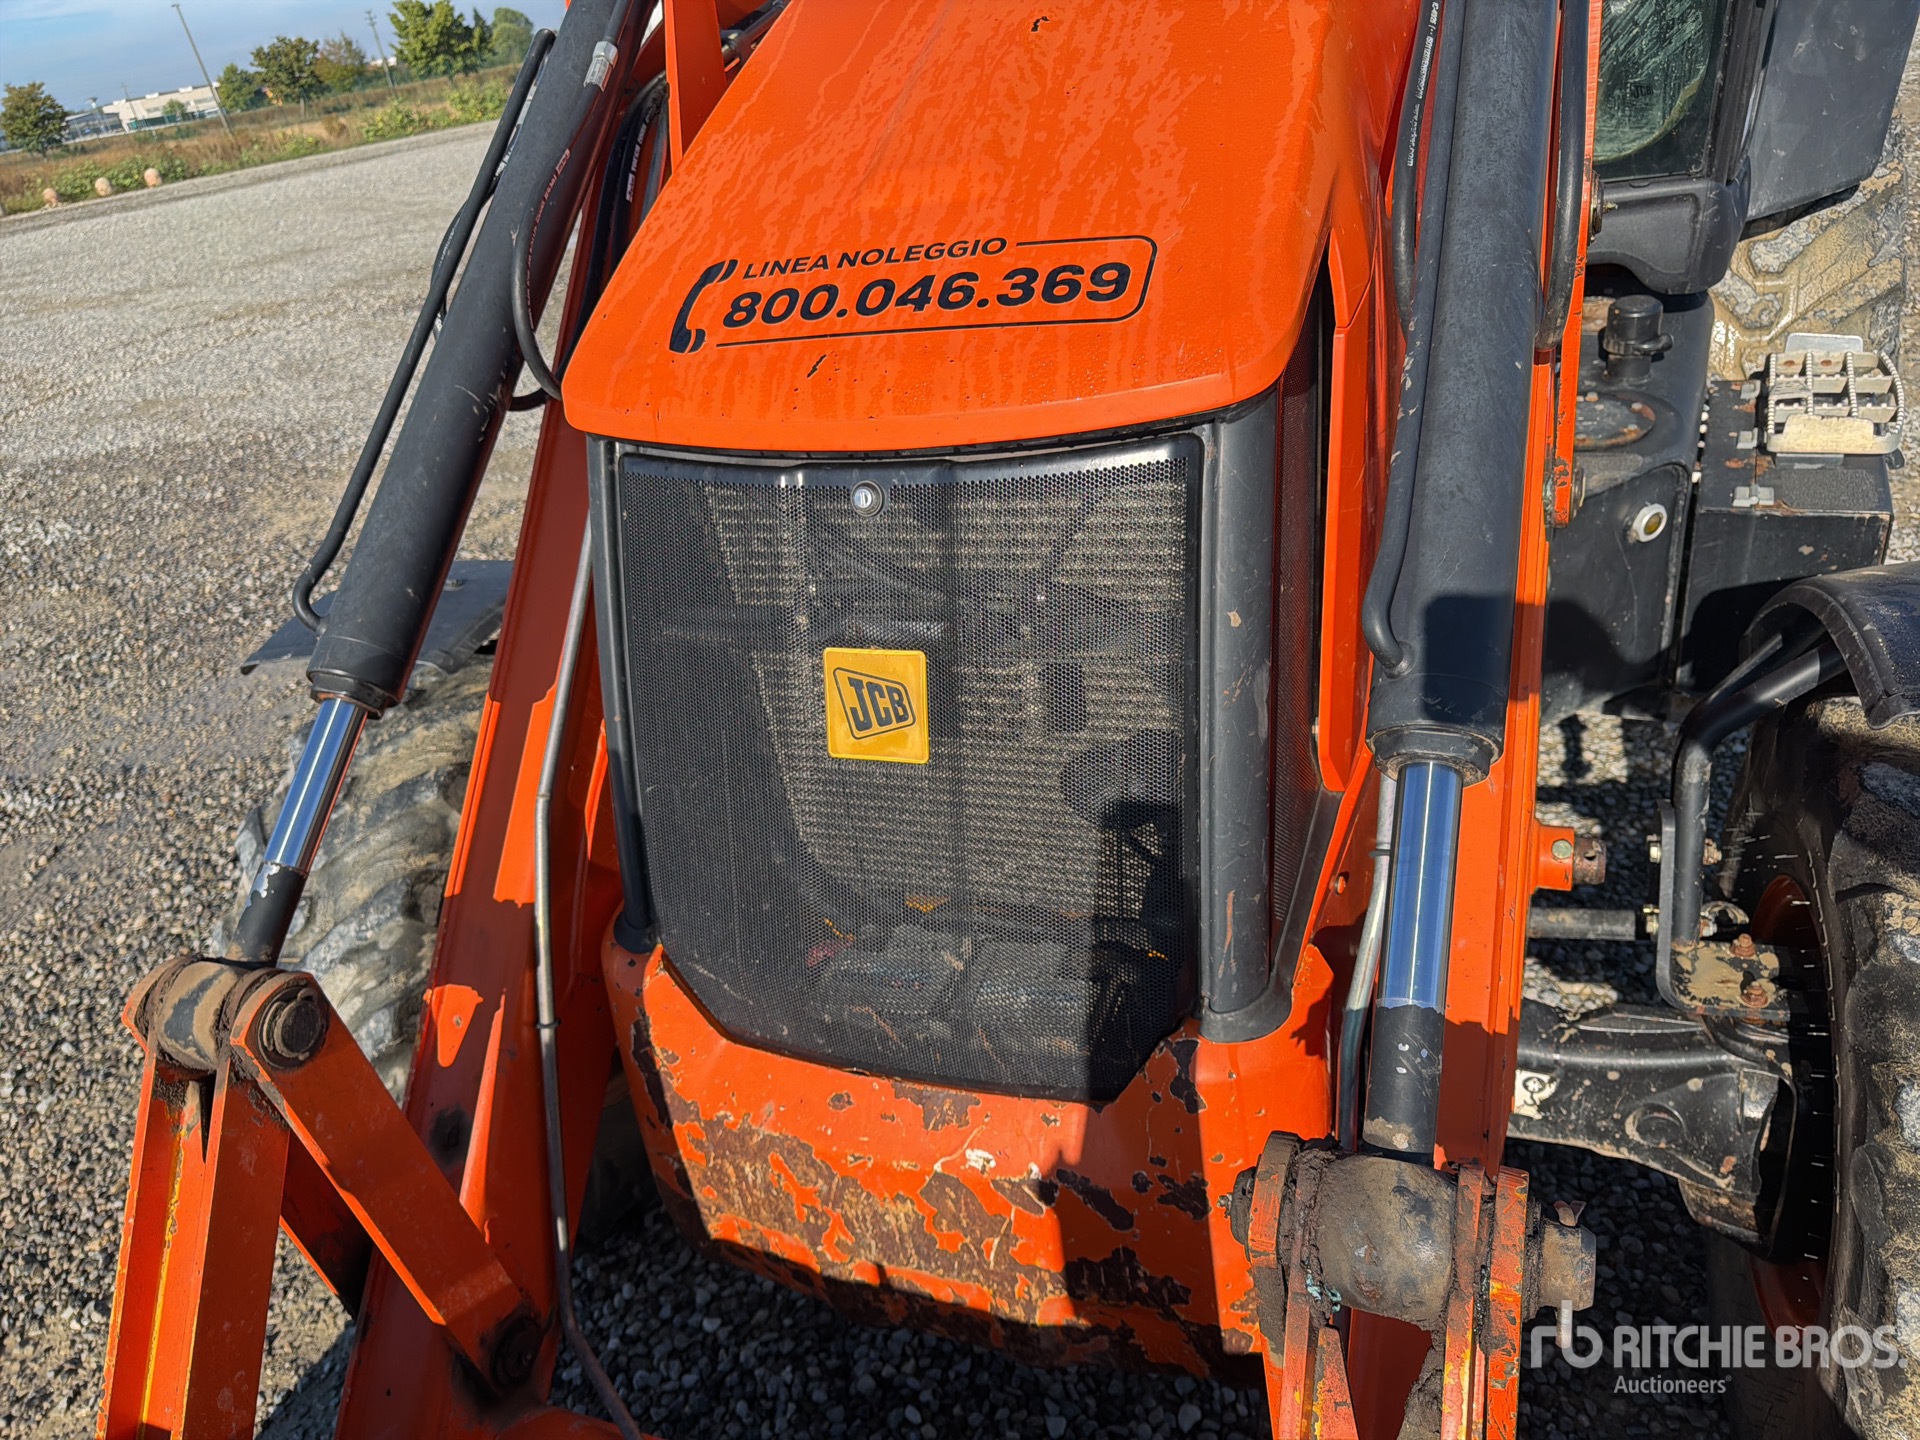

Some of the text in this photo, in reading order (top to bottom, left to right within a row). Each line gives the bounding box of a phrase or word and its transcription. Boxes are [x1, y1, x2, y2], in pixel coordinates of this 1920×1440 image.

[1633, 84, 1652, 99] JCB
[742, 237, 1007, 280] LINEA NOLEGGIO
[722, 261, 1132, 329] 800.046.369
[847, 676, 909, 732] JCB
